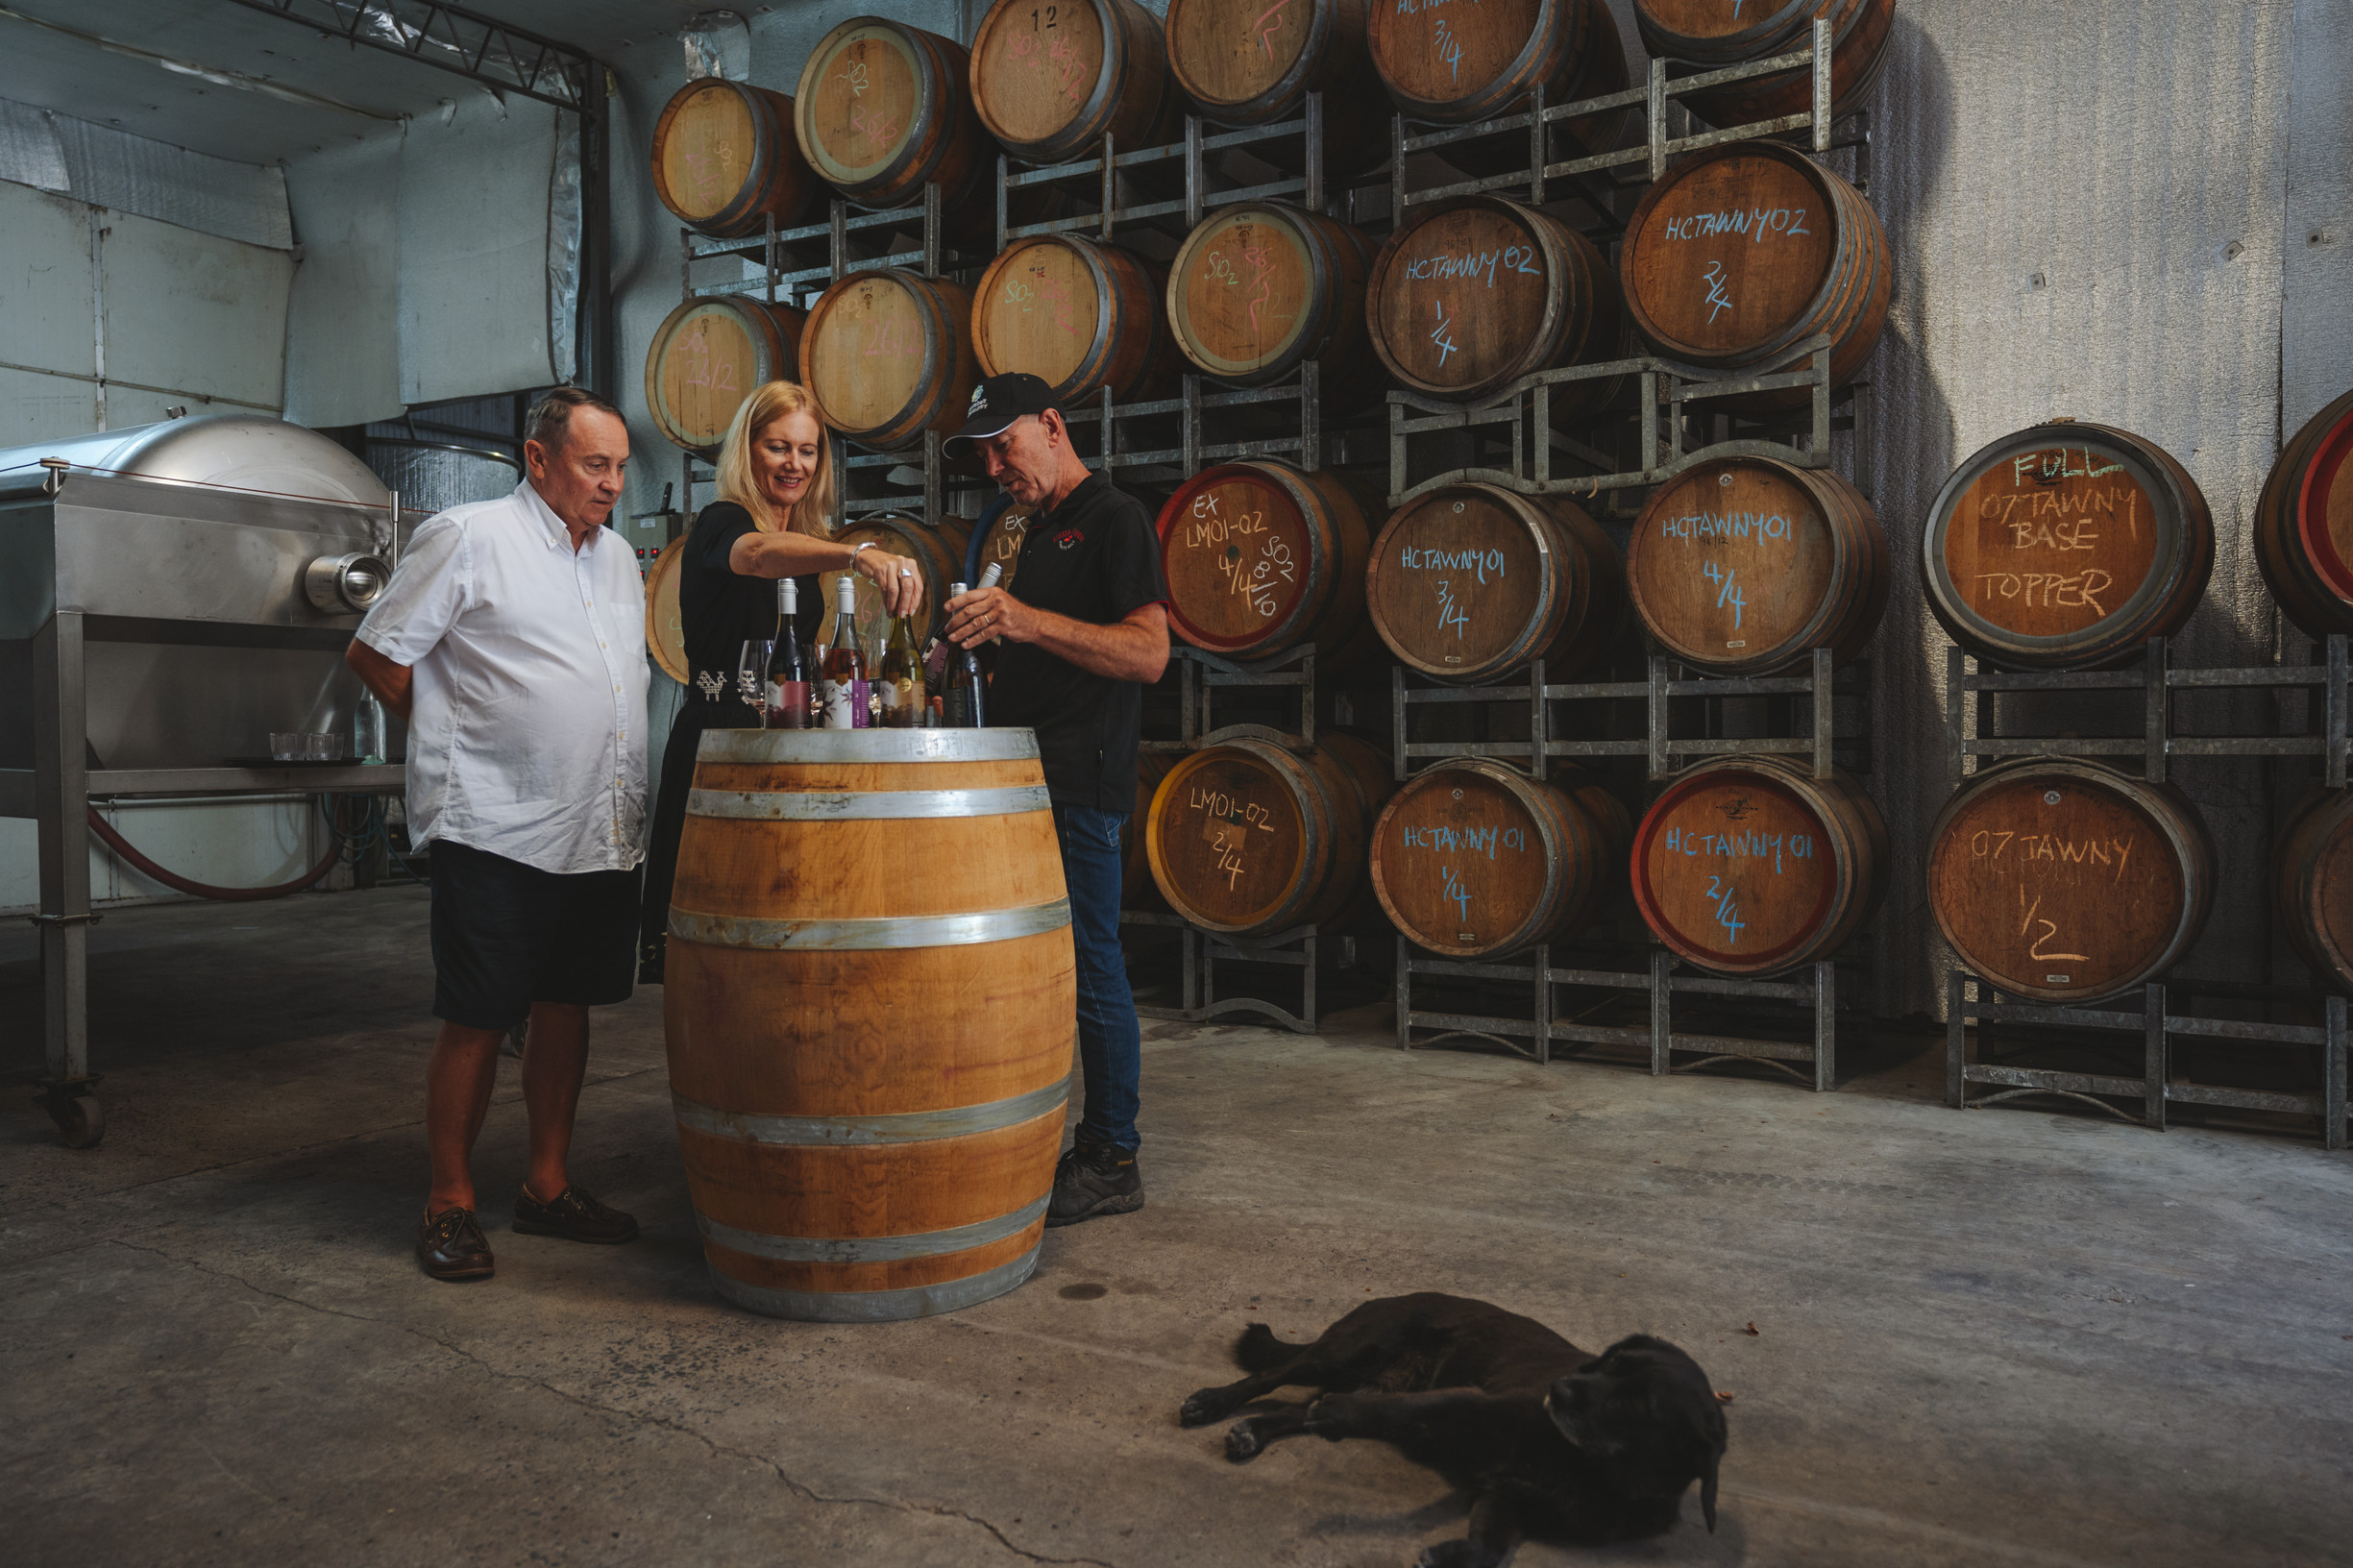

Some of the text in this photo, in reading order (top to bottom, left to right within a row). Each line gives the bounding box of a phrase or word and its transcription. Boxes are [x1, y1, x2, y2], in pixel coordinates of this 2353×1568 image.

[1434, 19, 1465, 85] 3/4
[1703, 260, 1732, 325] 2/4
[1431, 300, 1458, 368] 1/4
[2014, 447, 2125, 486] FULL
[1005, 513, 1026, 533] EX
[1193, 494, 1219, 518] EX
[2008, 519, 2099, 551] BASE
[1218, 554, 1259, 615] 4/4
[1262, 536, 1294, 582] SO2
[1438, 580, 1469, 640] 3/4
[1703, 559, 1747, 630] 4/4
[1974, 569, 2114, 617] TOPPER
[1213, 832, 1244, 892] 2/4
[2020, 834, 2135, 885] TAWNY
[1442, 866, 1473, 921] 1/4
[1706, 875, 1745, 944] 2/4
[2020, 883, 2090, 961] 1/2
